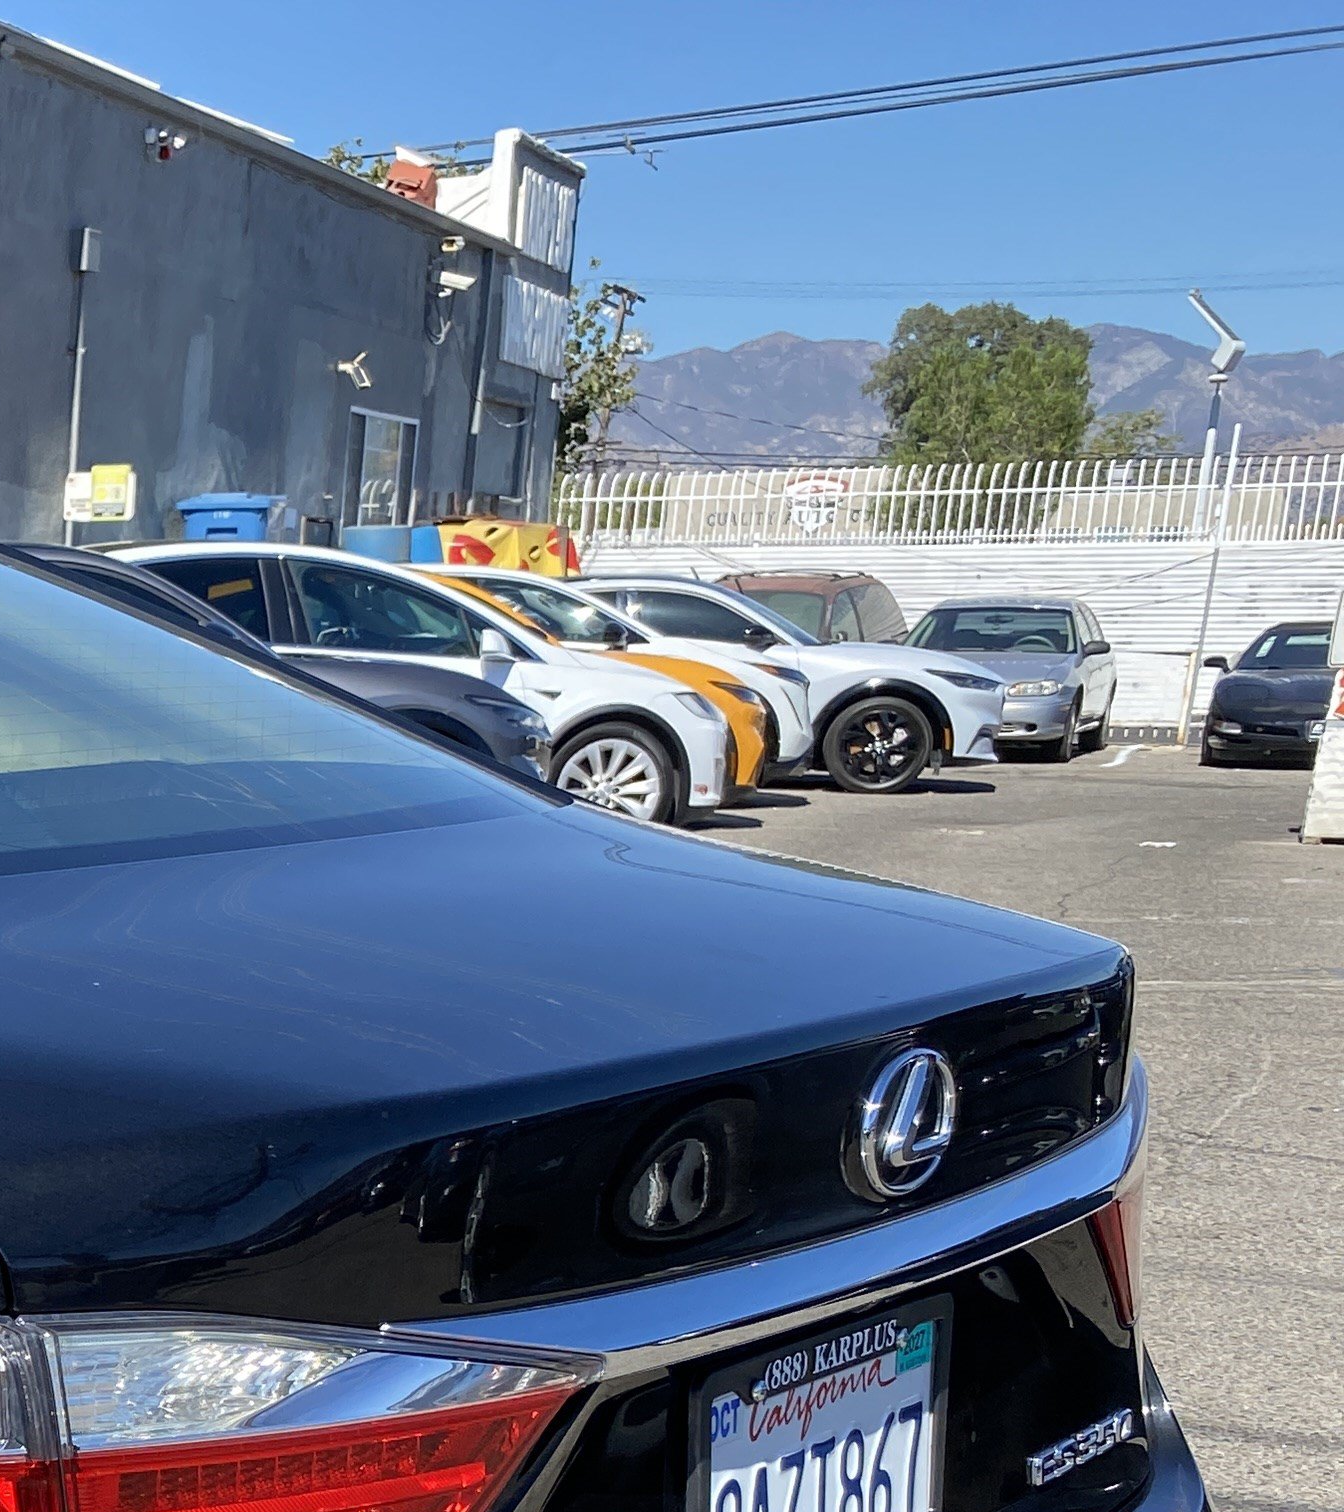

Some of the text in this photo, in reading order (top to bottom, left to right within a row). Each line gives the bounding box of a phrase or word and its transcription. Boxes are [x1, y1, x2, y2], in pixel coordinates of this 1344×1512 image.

[764, 1318, 897, 1391] (888) KARPLUS
[711, 1398, 741, 1443] OCT
[748, 1358, 897, 1442] California
[1026, 1408, 1133, 1486] ES350
